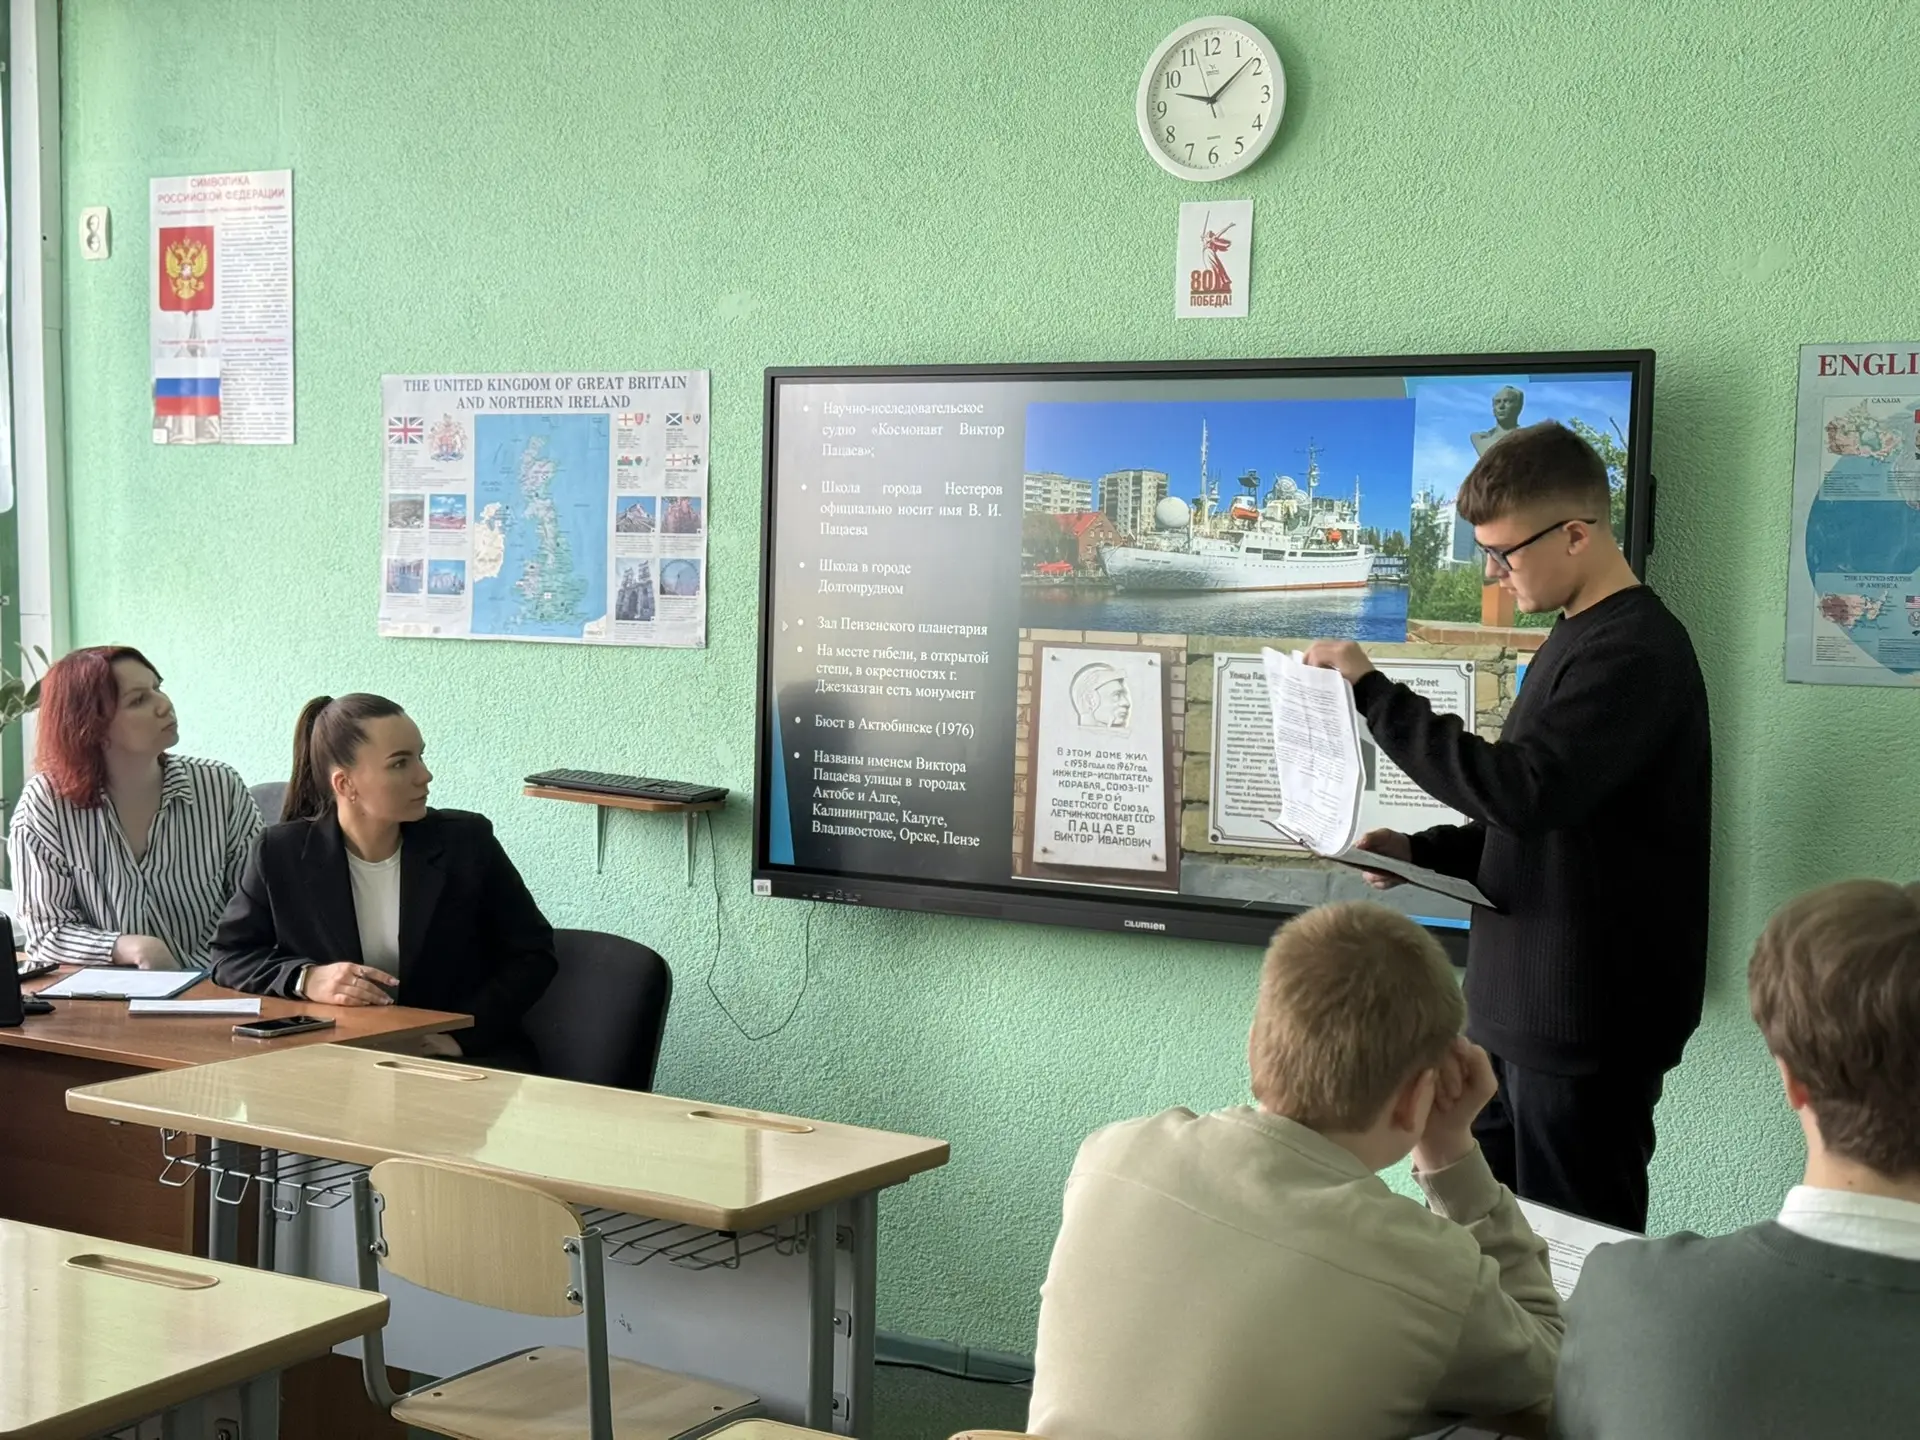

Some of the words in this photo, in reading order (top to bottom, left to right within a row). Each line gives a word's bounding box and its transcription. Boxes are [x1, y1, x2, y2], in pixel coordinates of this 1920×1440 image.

[1204, 37, 1221, 56] 12
[1235, 40, 1242, 58] 1
[1182, 48, 1196, 67] 11
[1252, 57, 1263, 76] 2
[1165, 70, 1181, 89] 10
[1261, 85, 1271, 103] 3
[1157, 101, 1167, 119] 9
[1252, 114, 1263, 131] 4
[1166, 125, 1176, 143] 8
[1185, 143, 1195, 161] 7
[1235, 136, 1244, 155] 5
[1208, 146, 1219, 164] 6
[190, 176, 250, 187] СИМВОЛИКА
[157, 190, 222, 203] РОССИЙСКОЙ
[225, 188, 285, 200] ФЕДЕРАЦИИ
[1191, 270, 1213, 291] 80
[1190, 295, 1232, 307] ПОБЕДА!
[404, 379, 430, 392] THE
[434, 378, 483, 391] UNITED
[487, 378, 550, 391] KINGDOM
[555, 378, 572, 390] OF
[577, 376, 624, 390] GREAT
[628, 376, 687, 389] BRITAIN
[456, 397, 485, 409] AND
[489, 396, 564, 409] NORTHERN
[568, 395, 630, 408] IRELAND
[823, 401, 984, 417] Научно-исследовательское
[822, 425, 856, 437] судно
[871, 422, 943, 436] «Космонавт
[959, 423, 1005, 438] Виктор
[822, 481, 861, 494] Школа
[882, 484, 922, 497] города
[945, 482, 1003, 498] Нестеров
[820, 502, 892, 516] официально
[898, 505, 933, 516] носит
[939, 505, 962, 516] имя
[969, 504, 982, 517] В.
[988, 504, 1002, 517] И.
[820, 523, 868, 537] Пацаева
[819, 559, 858, 573] Школа
[862, 563, 868, 572] в
[872, 563, 911, 576] городе
[818, 580, 903, 596] Долгопрудном
[817, 616, 837, 629] Зал
[841, 617, 915, 632] Пензенского
[918, 624, 988, 638] планетария
[817, 644, 833, 656] На
[836, 648, 869, 658] месте
[873, 647, 917, 663] гибели,
[920, 653, 928, 661] в
[931, 651, 989, 665] открытой
[816, 665, 852, 677] степи,
[856, 667, 862, 676] в
[866, 669, 946, 680] окрестностях
[950, 671, 957, 681] г.
[815, 680, 883, 695] Джезказган
[887, 687, 912, 697] есть
[916, 688, 976, 701] монумент
[1416, 677, 1440, 687] Street
[815, 715, 845, 729] Бюст
[848, 721, 855, 729] в
[858, 718, 933, 734] Актюбинске
[935, 722, 975, 739] (1976)
[814, 751, 864, 766] Названы
[868, 758, 912, 769] именем
[916, 757, 966, 774] Виктора
[1057, 747, 1063, 755] В
[1066, 749, 1091, 757] ЭТОМ
[1096, 751, 1121, 759] ДОМЕ
[1126, 753, 1148, 761] ЖИЛ
[814, 768, 861, 784] Пацаева
[864, 774, 902, 787] улицы
[906, 779, 912, 787] в
[919, 779, 966, 792] городах
[1052, 769, 1153, 782] ИНЖЕНЕР-ИСПЫТАТЕЛЬ
[1059, 780, 1100, 790] КОРАБЛЯ
[813, 786, 855, 800] Актобе
[869, 791, 901, 806] Алге,
[1081, 792, 1122, 802] ГЕРОЙ
[812, 804, 899, 823] Калининграде,
[902, 810, 948, 827] Калуге,
[1134, 814, 1155, 823] СССР
[812, 821, 897, 841] Владивостоке,
[900, 828, 939, 845] Орске,
[942, 831, 980, 846] Пензе
[1068, 819, 1136, 835] ПАЦАЕВ
[1054, 830, 1094, 843] ВИКТОР
[1098, 835, 1151, 847] ИВАНОВИЧ
